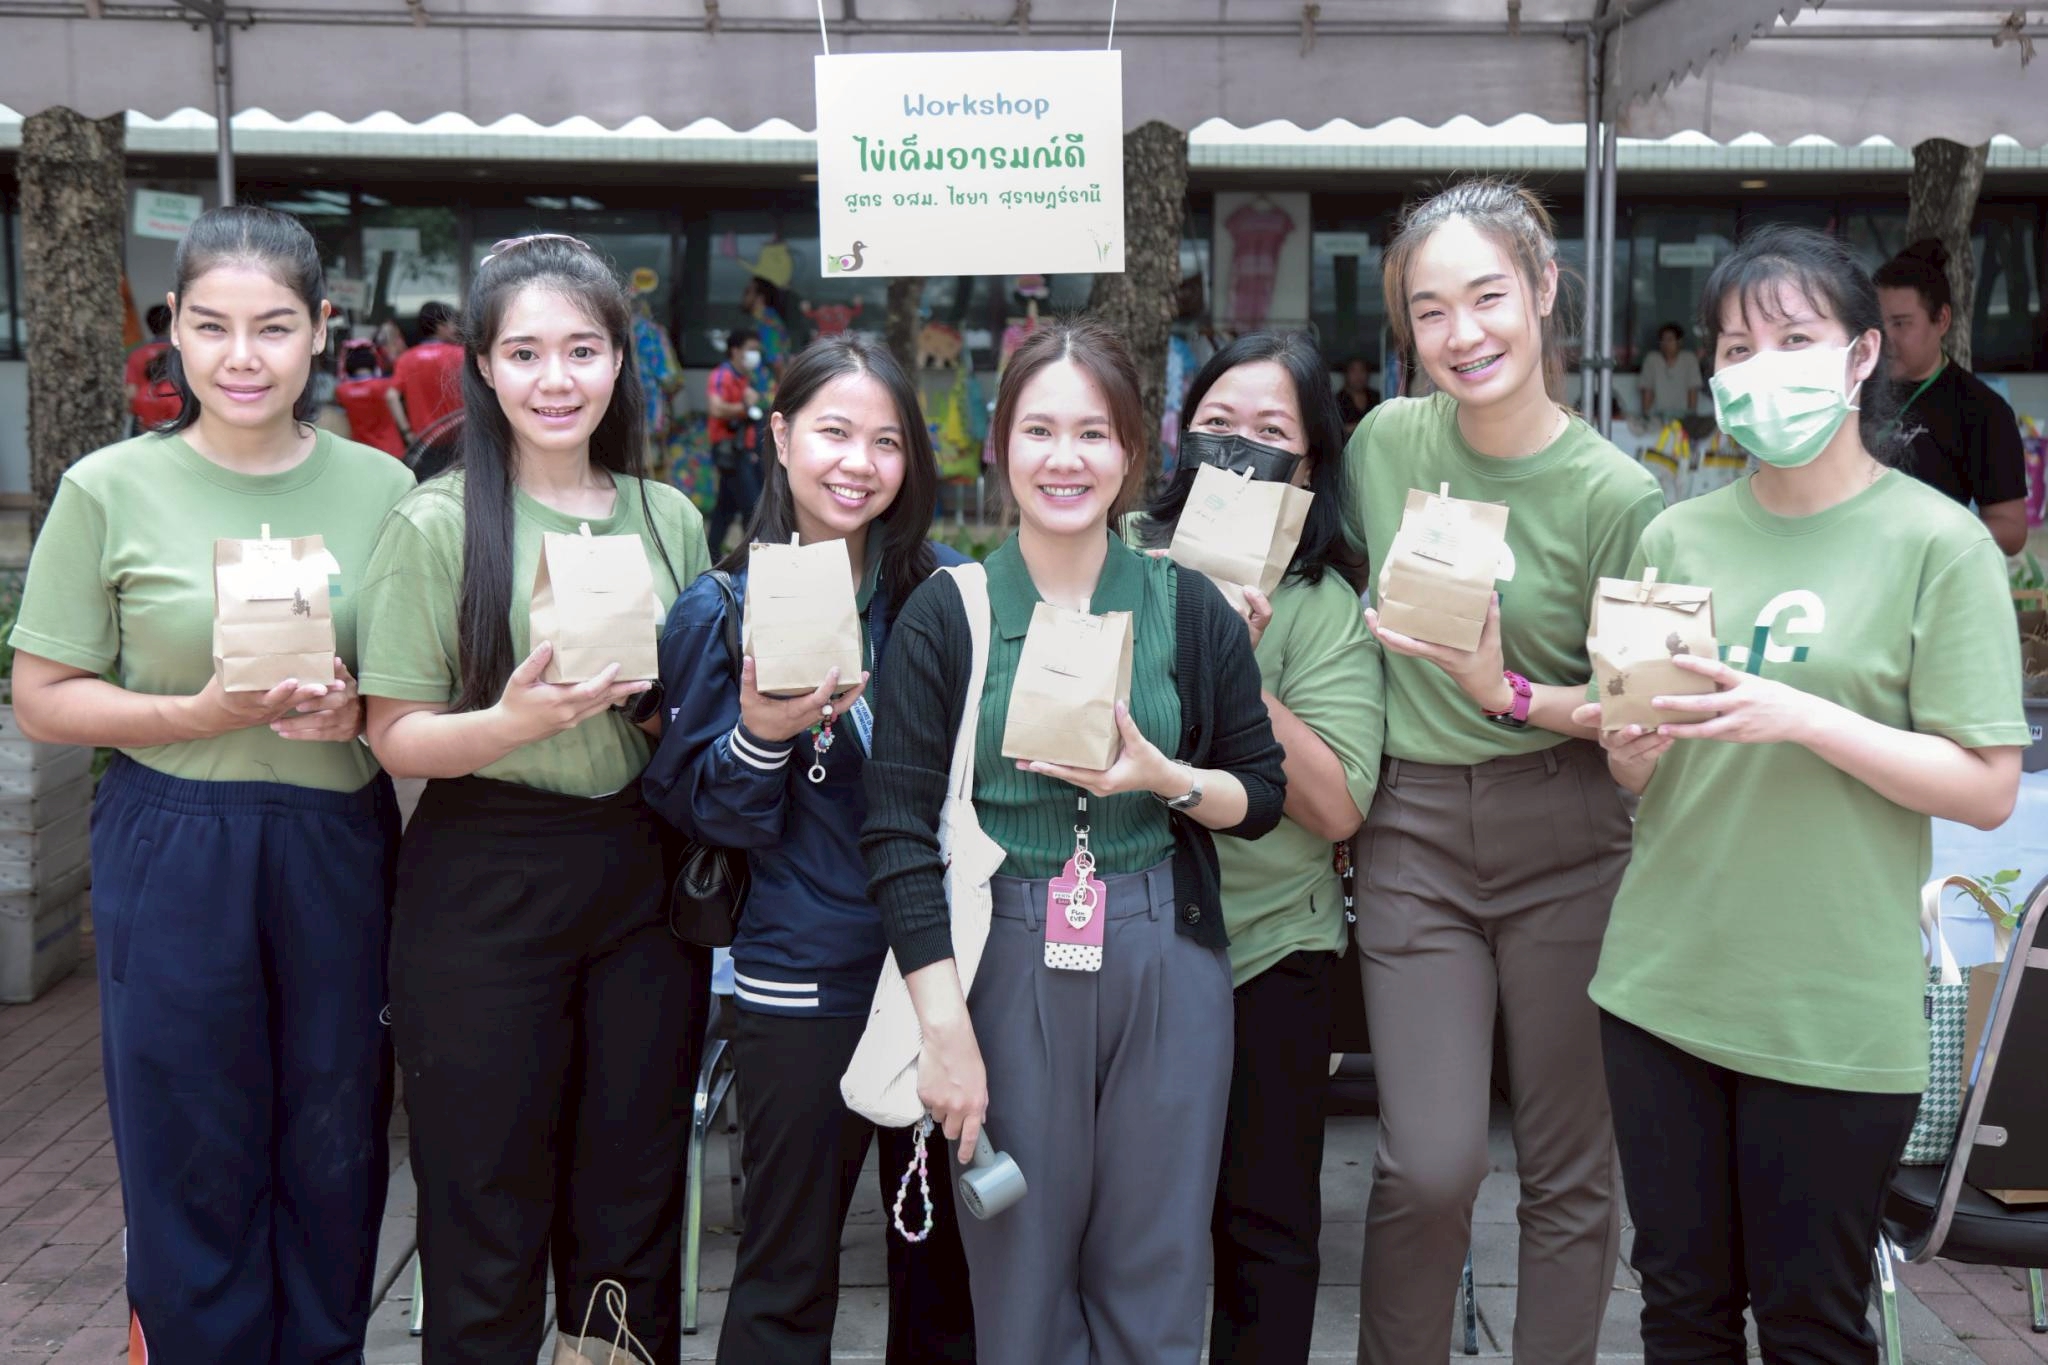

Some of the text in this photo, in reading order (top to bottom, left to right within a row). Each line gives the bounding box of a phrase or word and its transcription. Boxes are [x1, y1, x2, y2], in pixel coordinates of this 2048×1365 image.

[903, 93, 1050, 120] Workshop
[852, 133, 1086, 172] ไข่เค็มอารมณ์ดี
[844, 193, 882, 213] สูตร
[892, 192, 938, 206] อสม.
[946, 185, 988, 205] ไชยา
